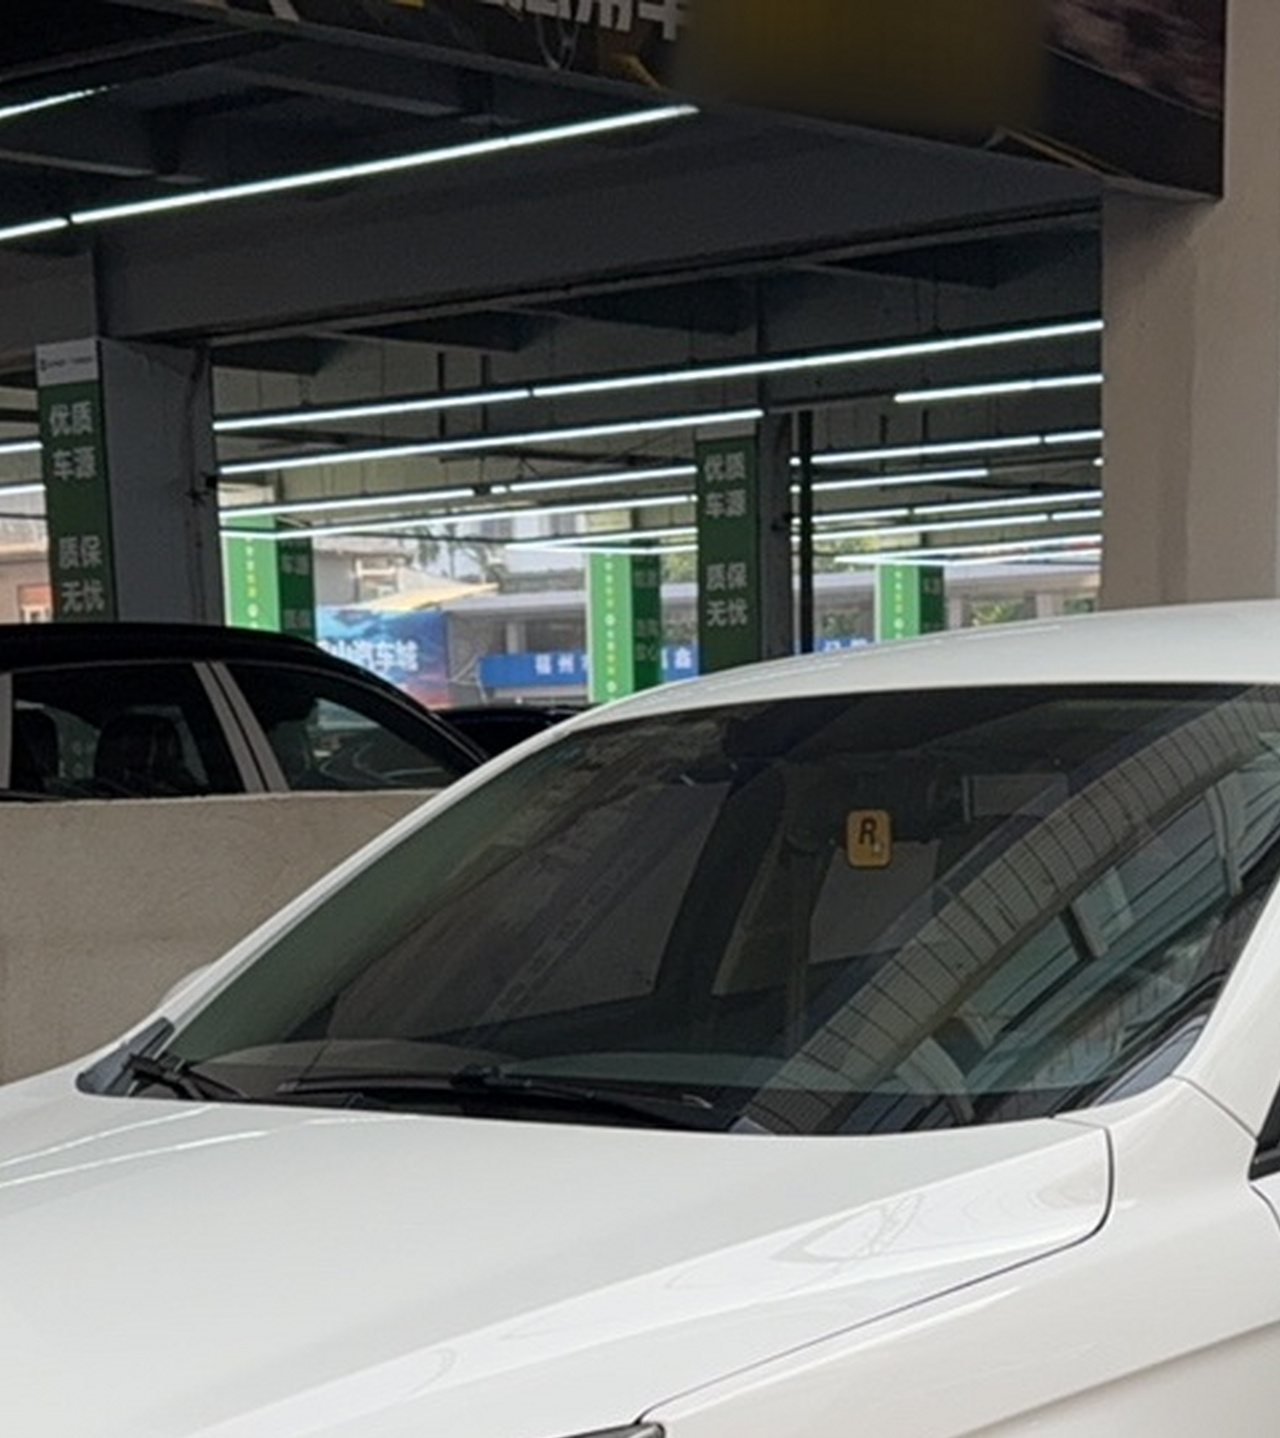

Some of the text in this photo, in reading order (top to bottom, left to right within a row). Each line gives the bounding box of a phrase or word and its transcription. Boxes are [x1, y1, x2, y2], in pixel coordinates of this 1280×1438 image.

[49, 401, 94, 436] 优质
[52, 447, 96, 480] 车源
[704, 452, 746, 482] 优质
[705, 489, 747, 518] 车源
[58, 536, 102, 569] 质保
[706, 562, 748, 590] 质保
[61, 579, 104, 612] 无忧
[707, 599, 749, 627] 无忧
